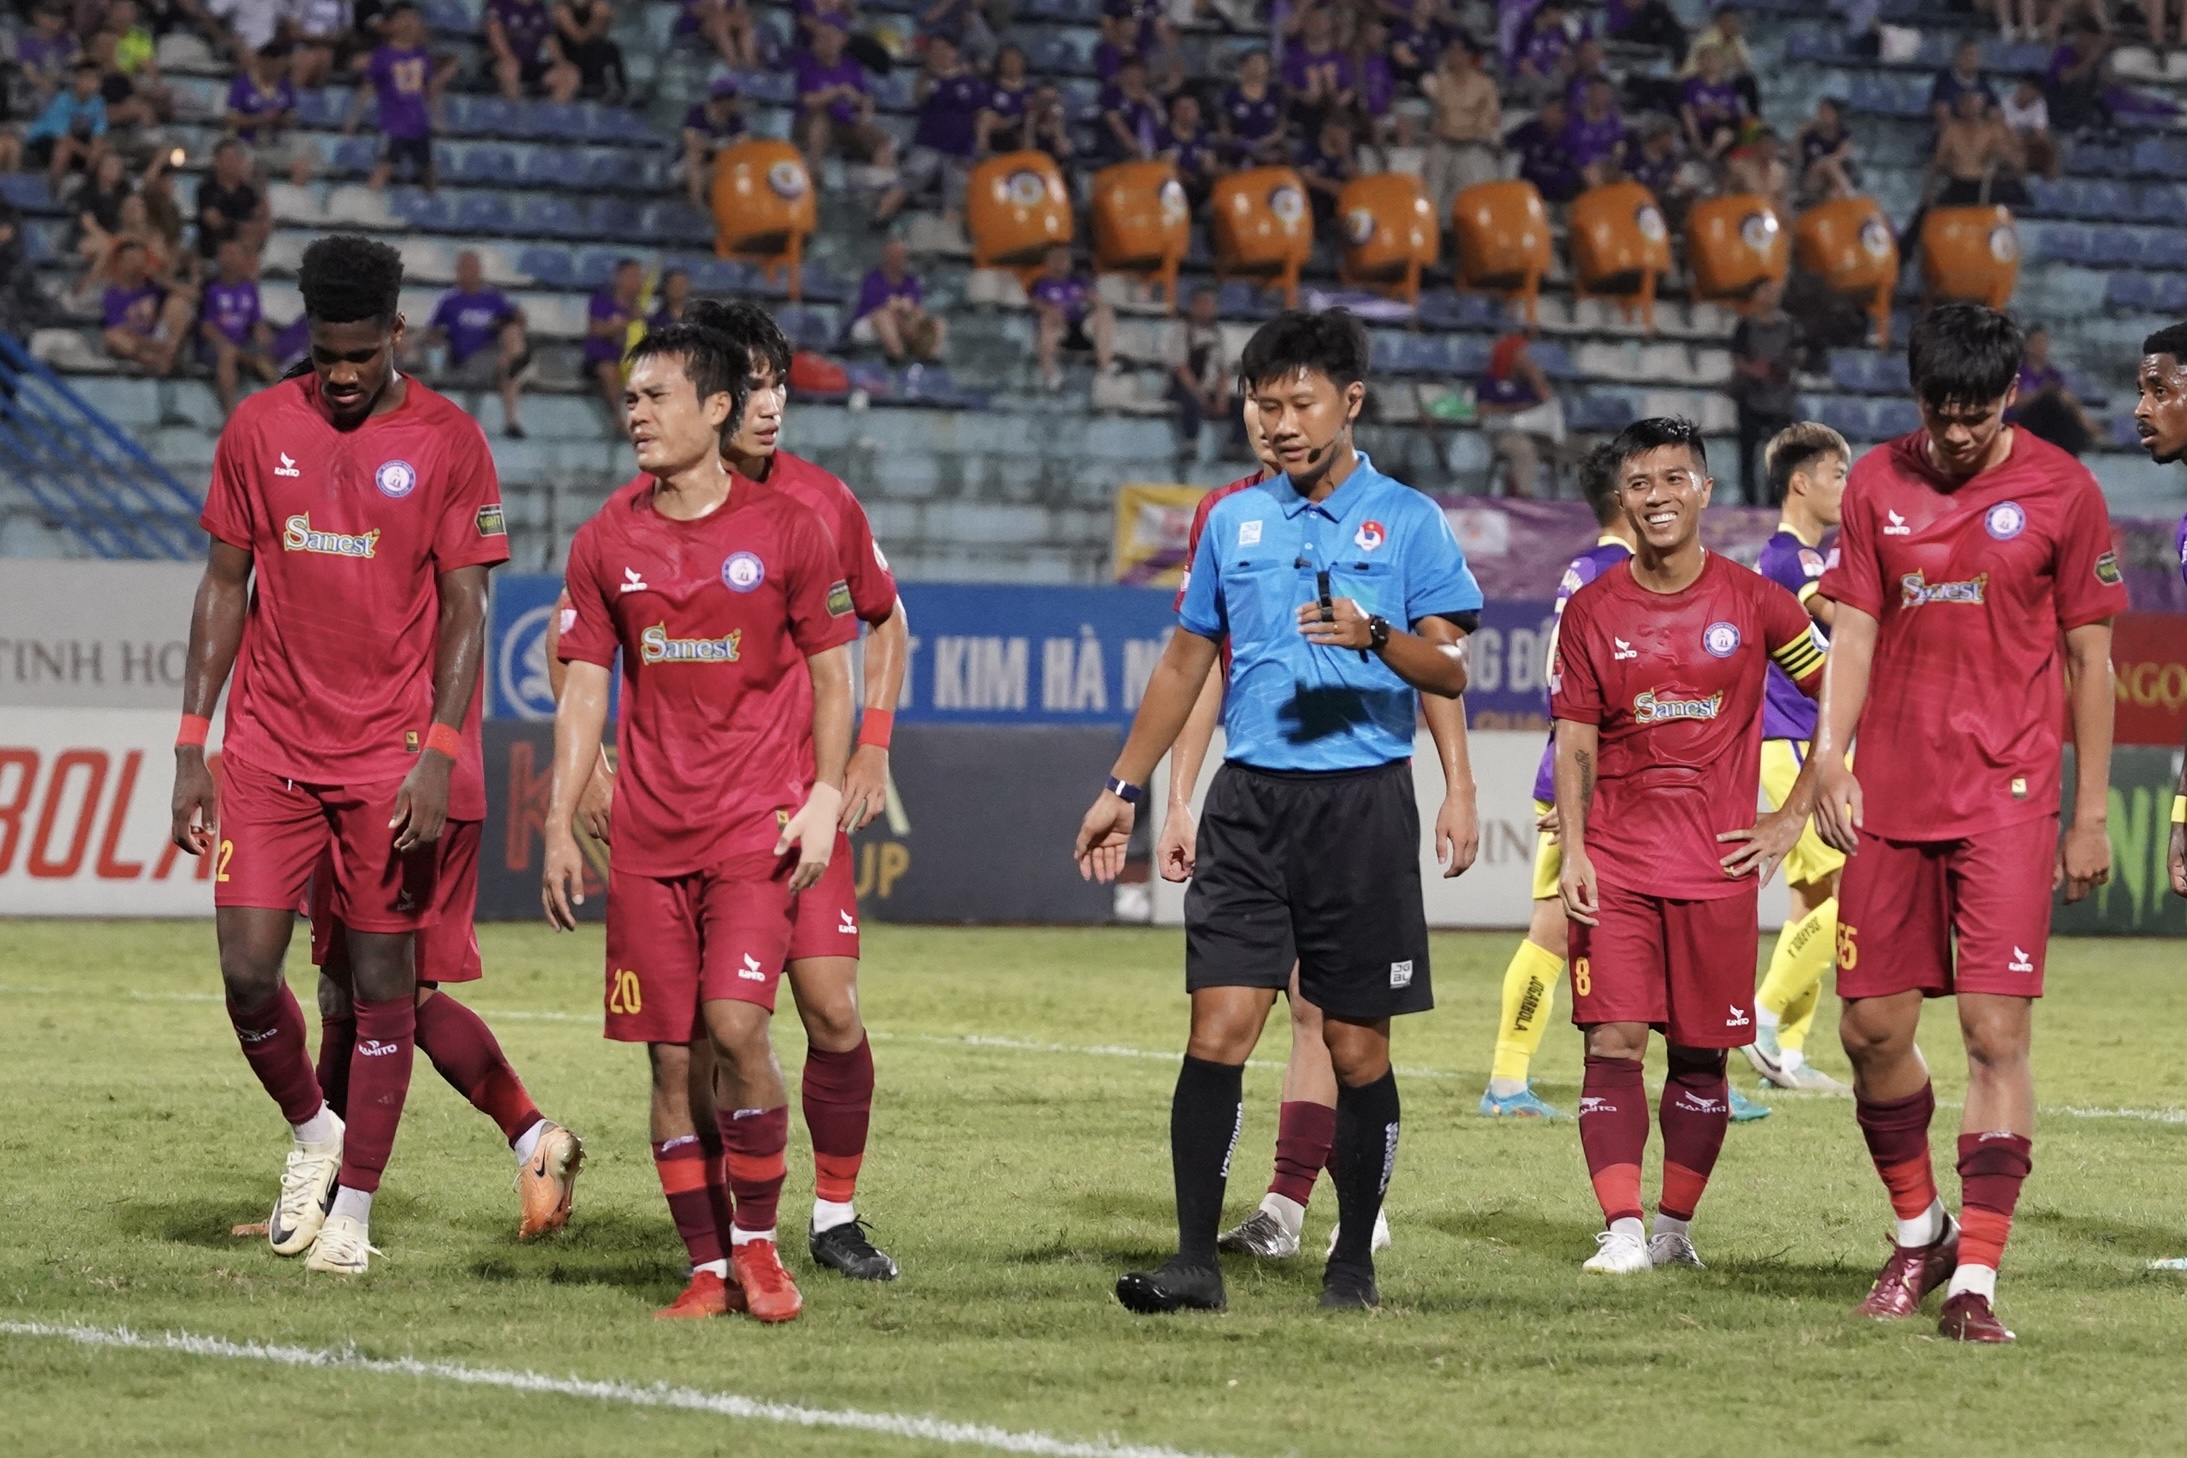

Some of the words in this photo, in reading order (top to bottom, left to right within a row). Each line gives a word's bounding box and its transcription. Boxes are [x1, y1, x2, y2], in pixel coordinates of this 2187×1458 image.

[284, 511, 379, 558] Sanest
[641, 621, 742, 665] Sanest
[933, 634, 1028, 711] KIM
[1041, 622, 1108, 712] HÀ
[1633, 687, 1724, 724] Sanest
[610, 968, 642, 1014] 20
[1575, 956, 1593, 997] 8
[1513, 975, 1545, 1032] JOGARBOLA
